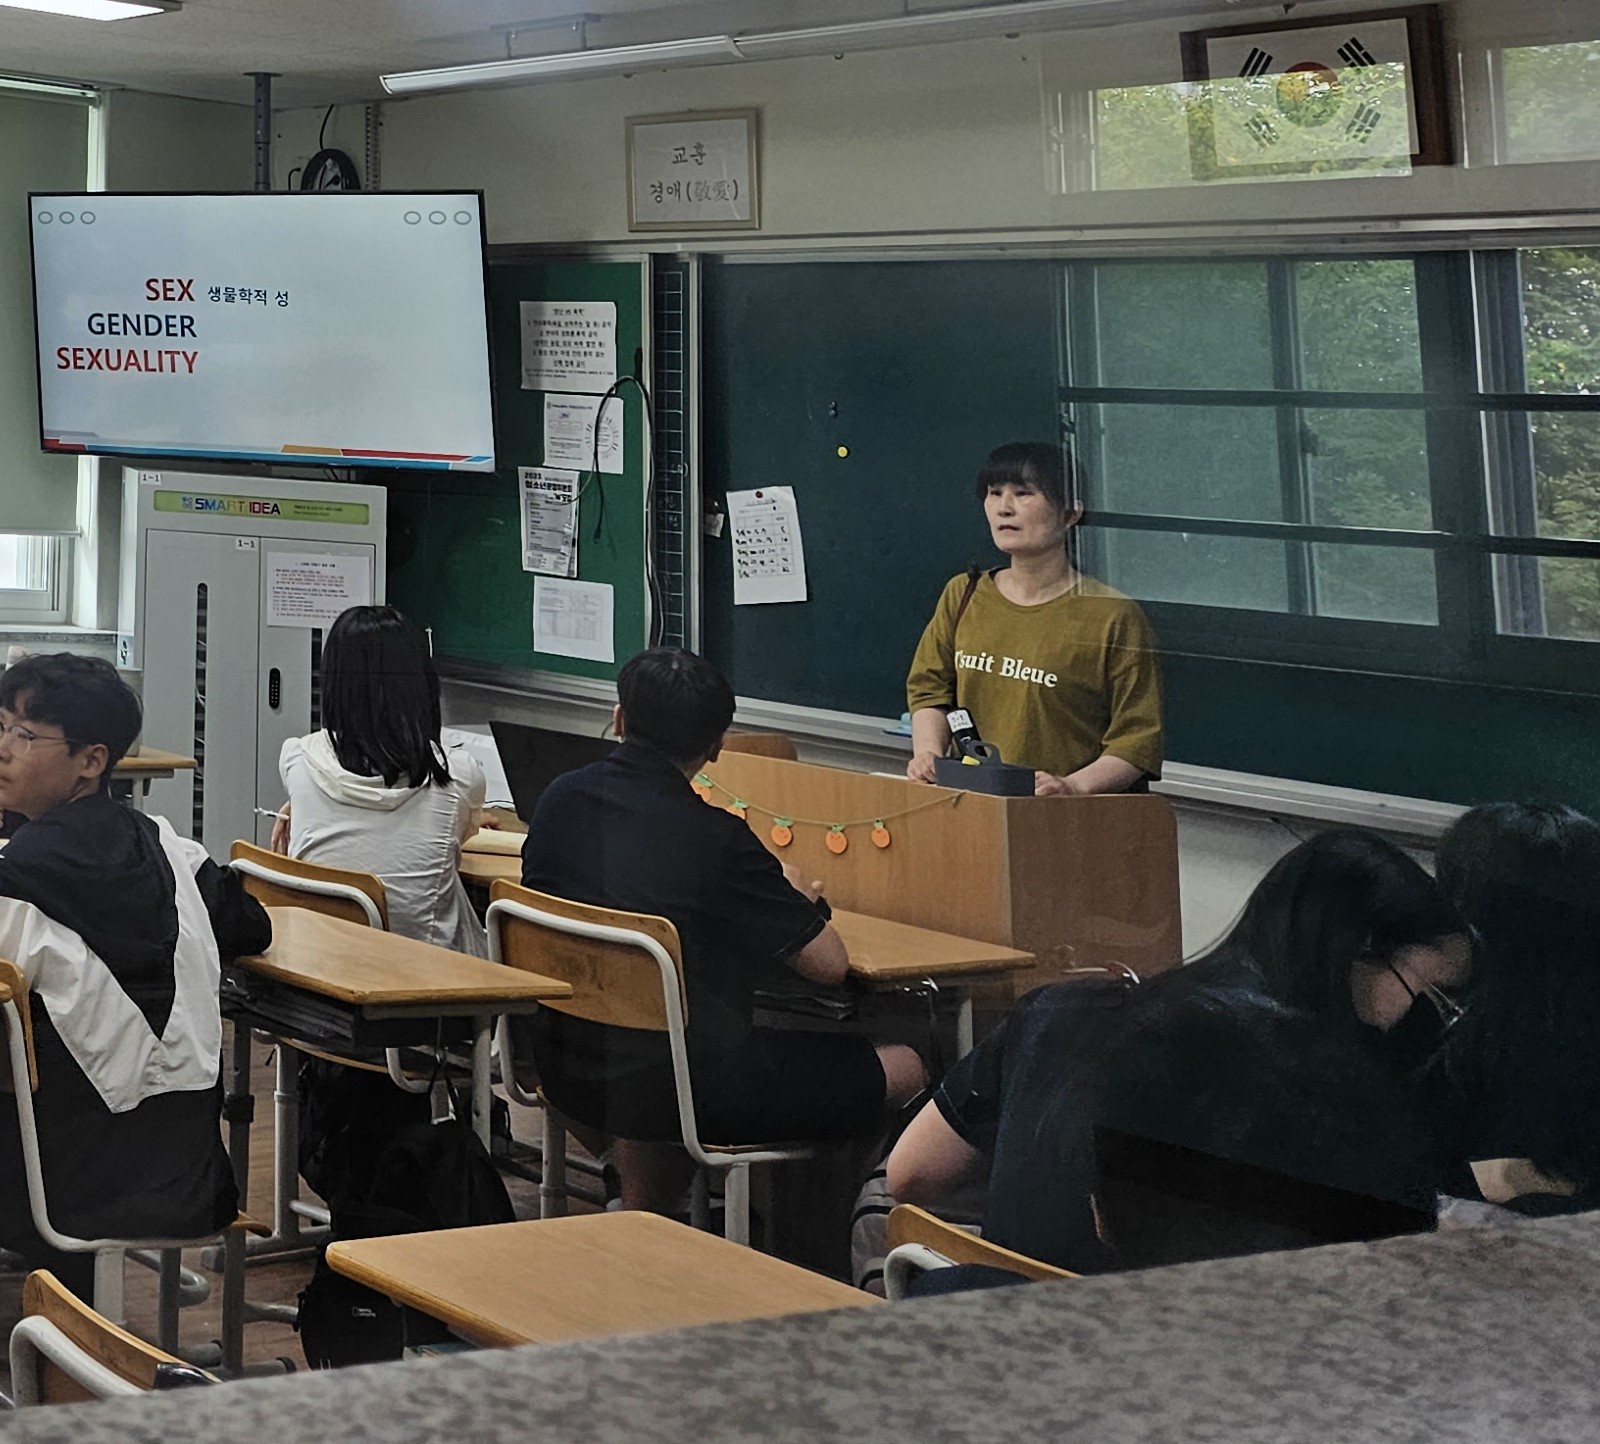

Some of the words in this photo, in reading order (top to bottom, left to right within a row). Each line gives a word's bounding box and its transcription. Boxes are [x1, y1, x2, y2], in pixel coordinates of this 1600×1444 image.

[672, 142, 706, 166] 교훈
[145, 278, 195, 302] SEX
[207, 286, 267, 306] 생물학적
[274, 290, 289, 308] 성
[87, 312, 198, 338] GENDER
[56, 346, 198, 374] SEXUALITY
[142, 473, 160, 481] 1-1
[524, 471, 542, 480] 2023
[195, 498, 245, 513] SMART
[249, 501, 281, 515] IDEA
[237, 539, 255, 548] 1-1
[999, 656, 1058, 688] Bleue
